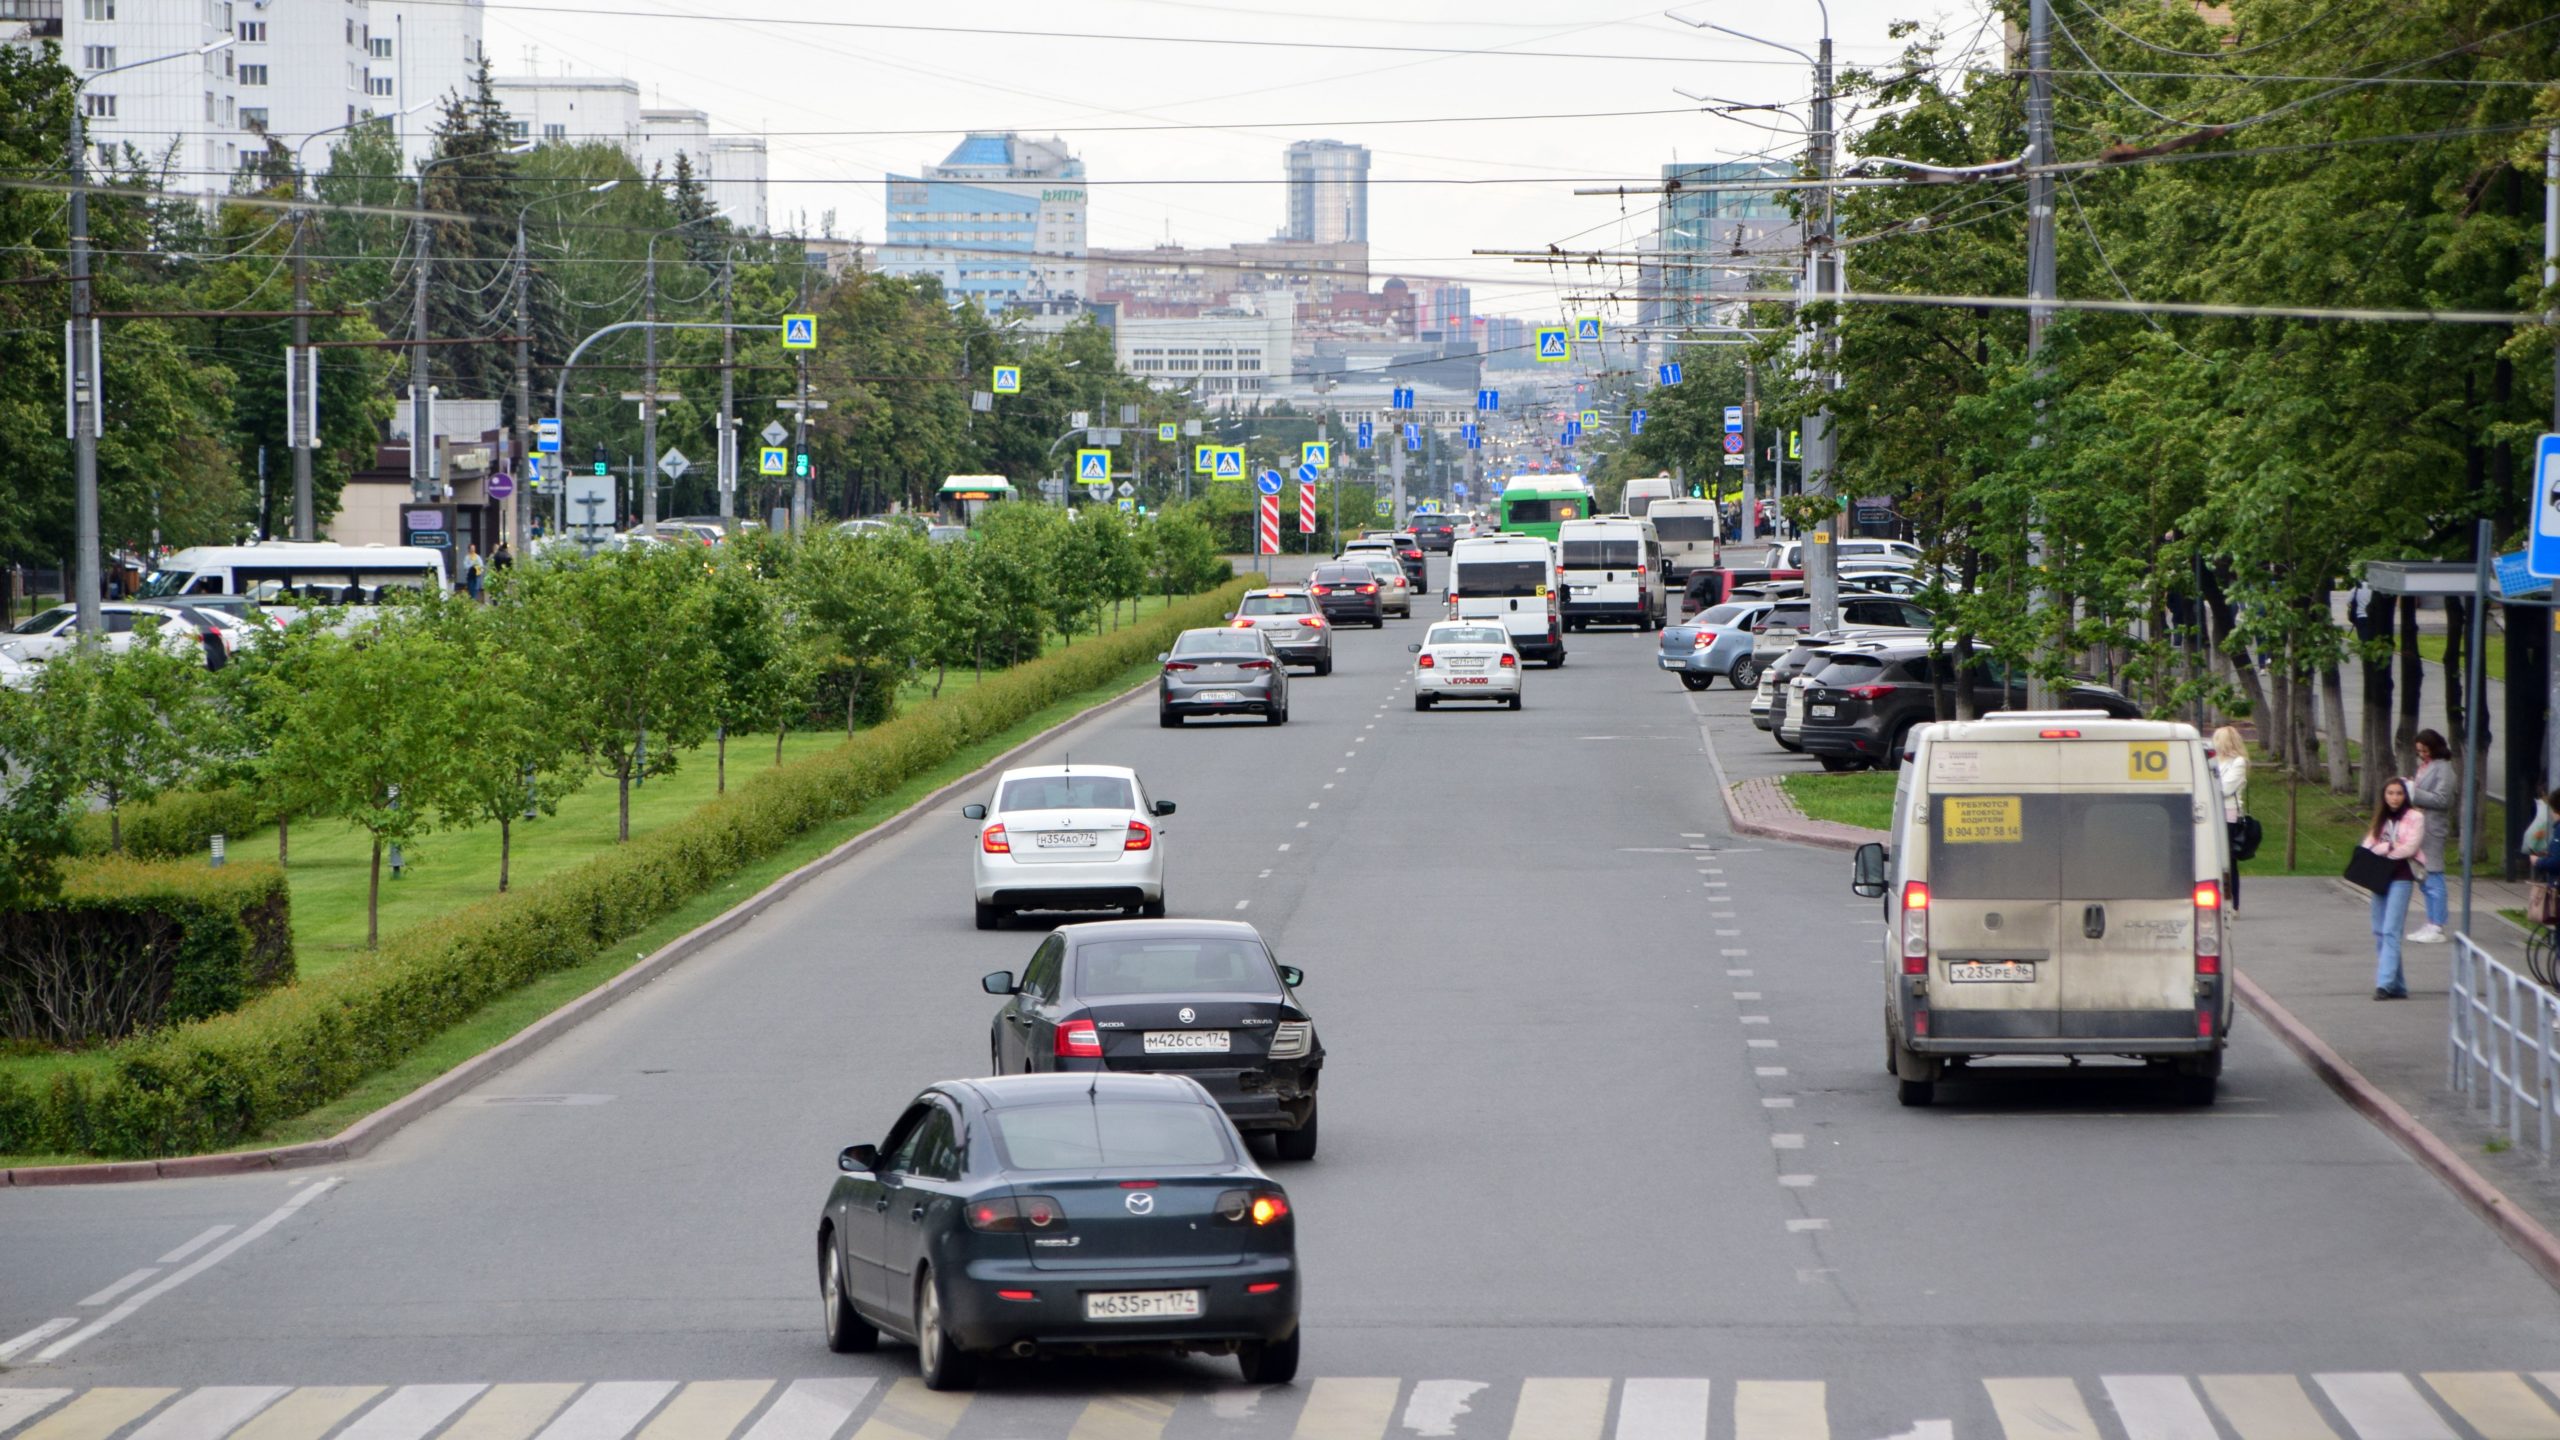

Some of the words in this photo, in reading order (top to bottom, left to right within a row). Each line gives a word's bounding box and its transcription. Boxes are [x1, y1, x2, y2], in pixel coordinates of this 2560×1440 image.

[1537, 586, 1546, 596] 3
[2131, 750, 2168, 773] 10
[1947, 828, 1953, 837] 8
[1956, 827, 1972, 837] 904
[1993, 826, 2005, 836] 58
[2008, 826, 2018, 835] 14
